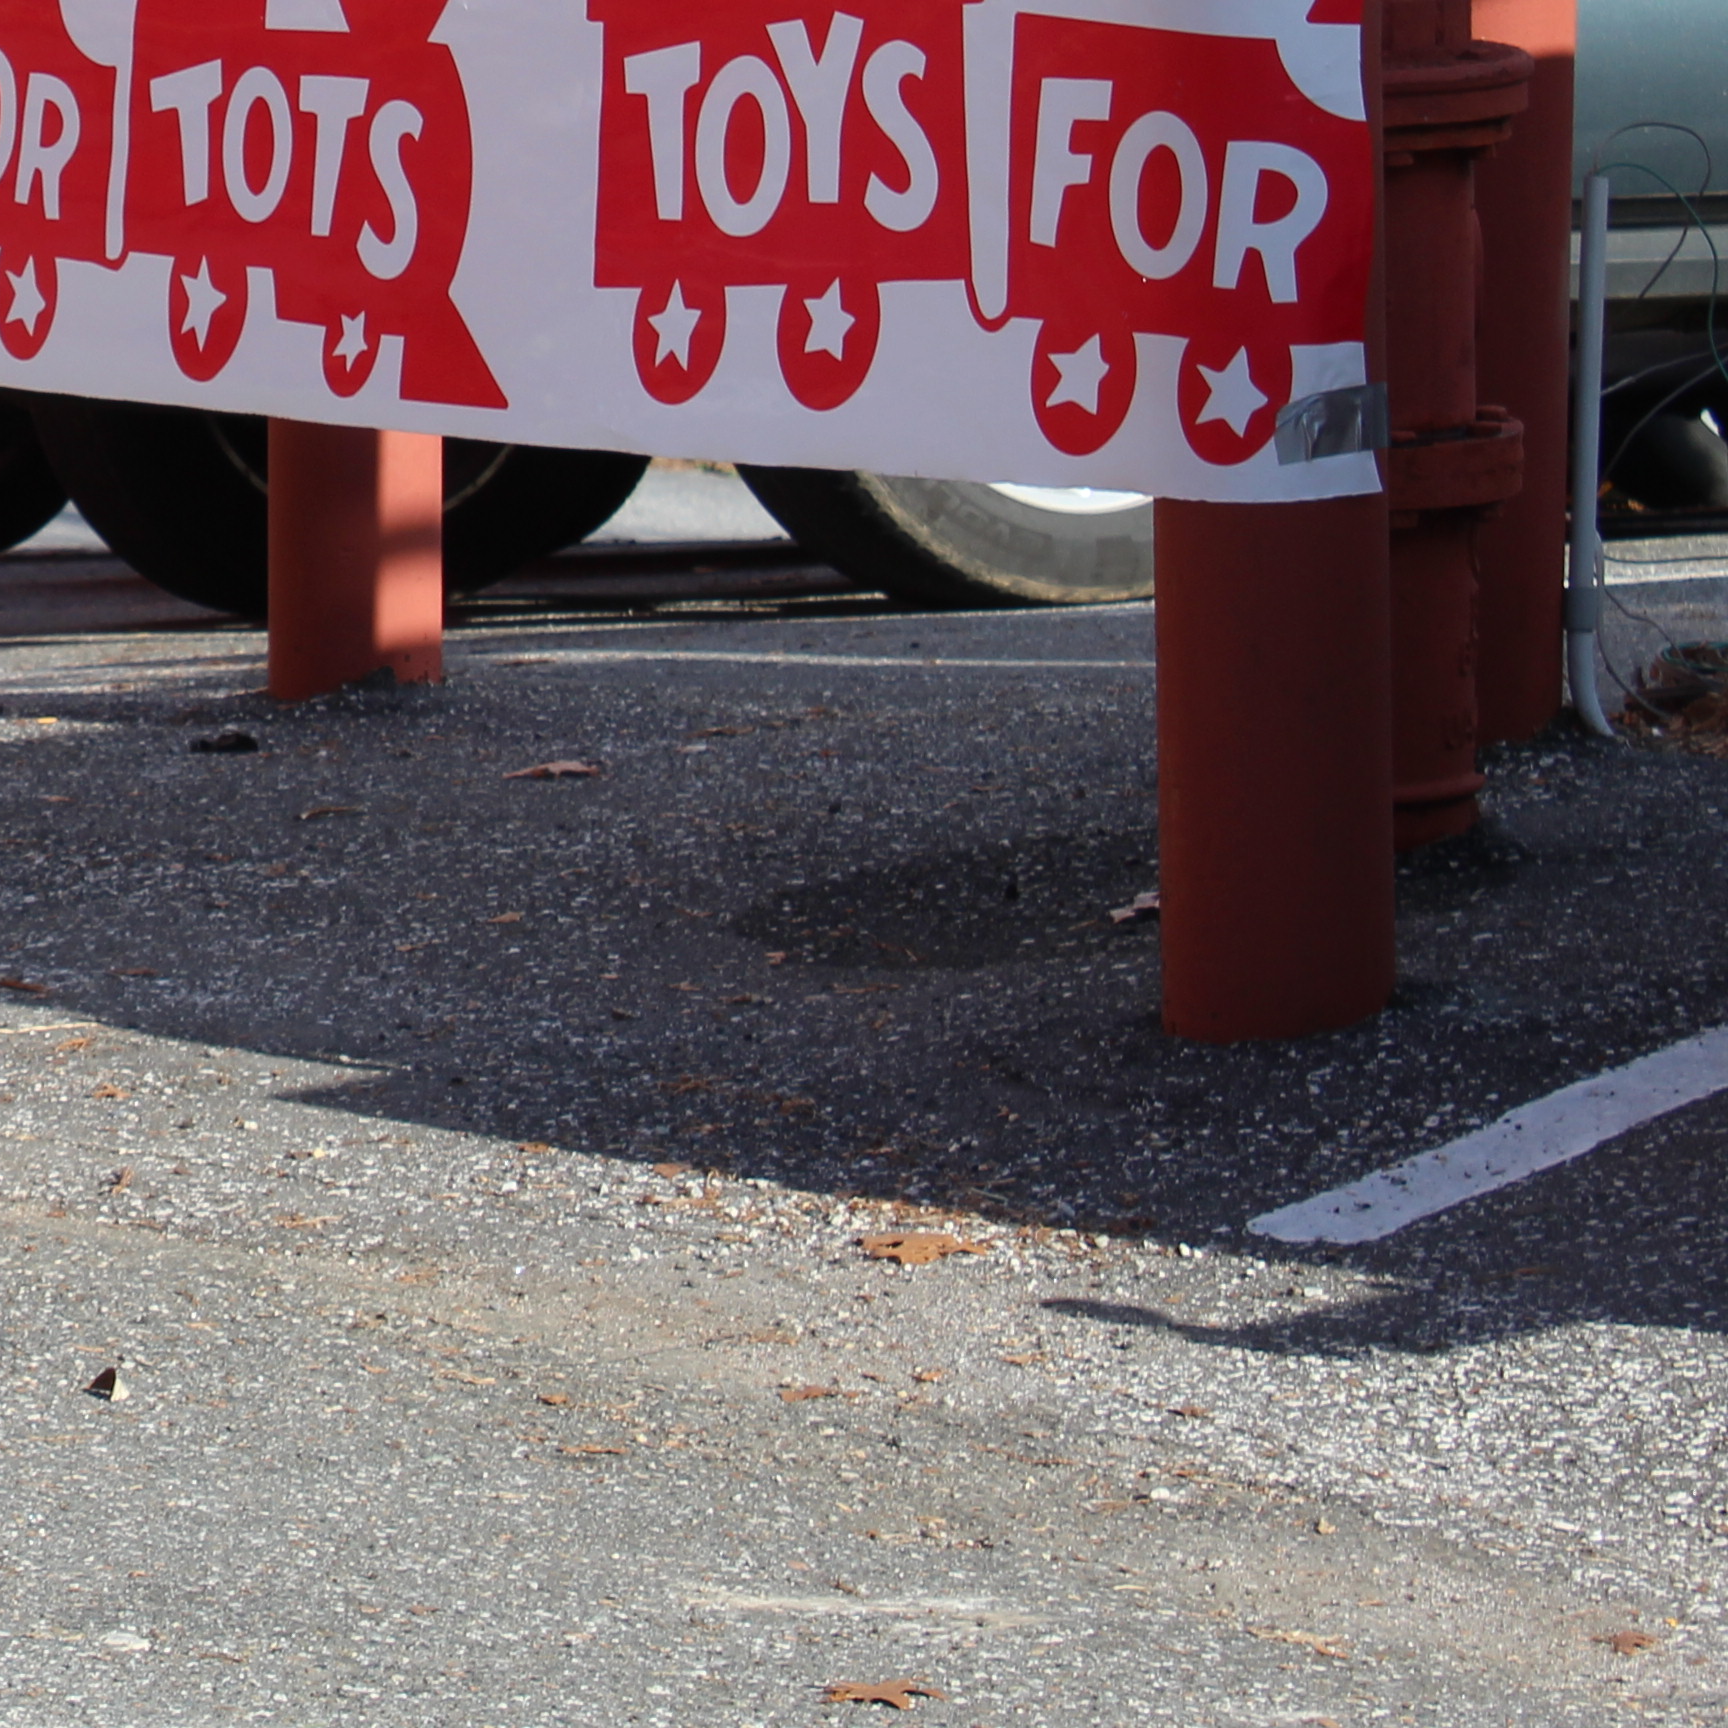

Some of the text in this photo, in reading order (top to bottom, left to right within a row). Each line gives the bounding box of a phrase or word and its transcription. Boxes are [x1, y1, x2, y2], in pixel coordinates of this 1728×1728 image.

[150, 58, 424, 281] TOTS
[624, 11, 1330, 304] TOYS FOR
